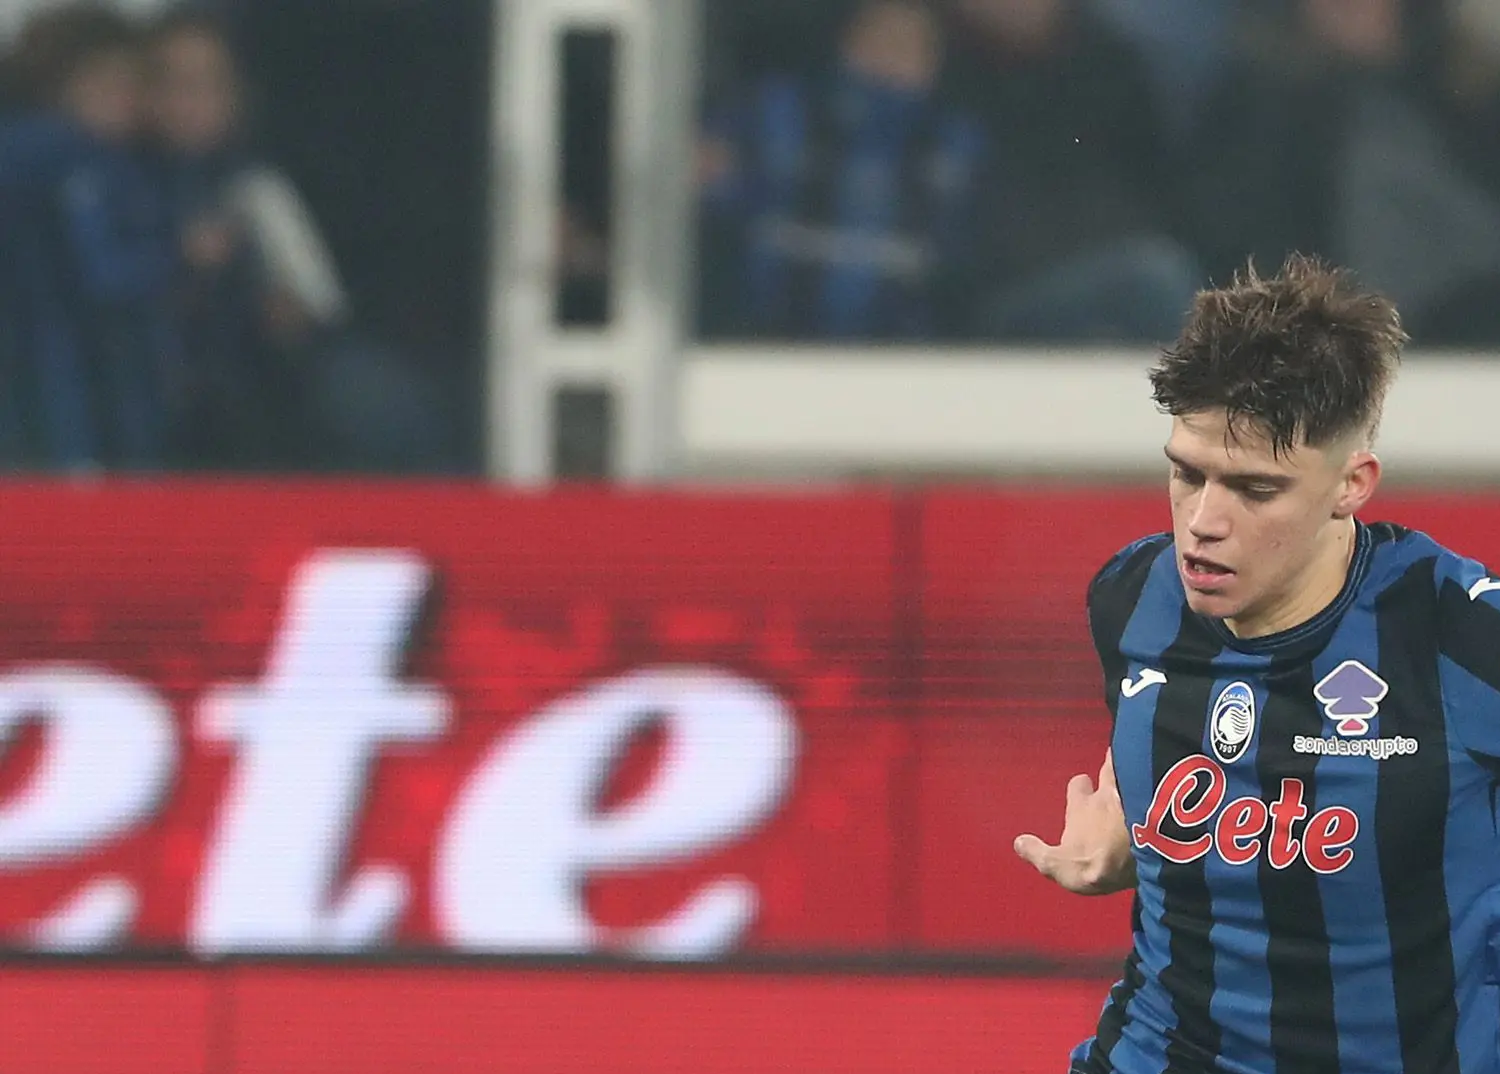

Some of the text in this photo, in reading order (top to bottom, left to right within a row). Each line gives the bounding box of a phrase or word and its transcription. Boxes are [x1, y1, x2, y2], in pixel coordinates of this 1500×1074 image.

[1218, 742, 1238, 754] 1907
[1293, 736, 1418, 760] zondacrypto
[1132, 754, 1359, 874] Lete
